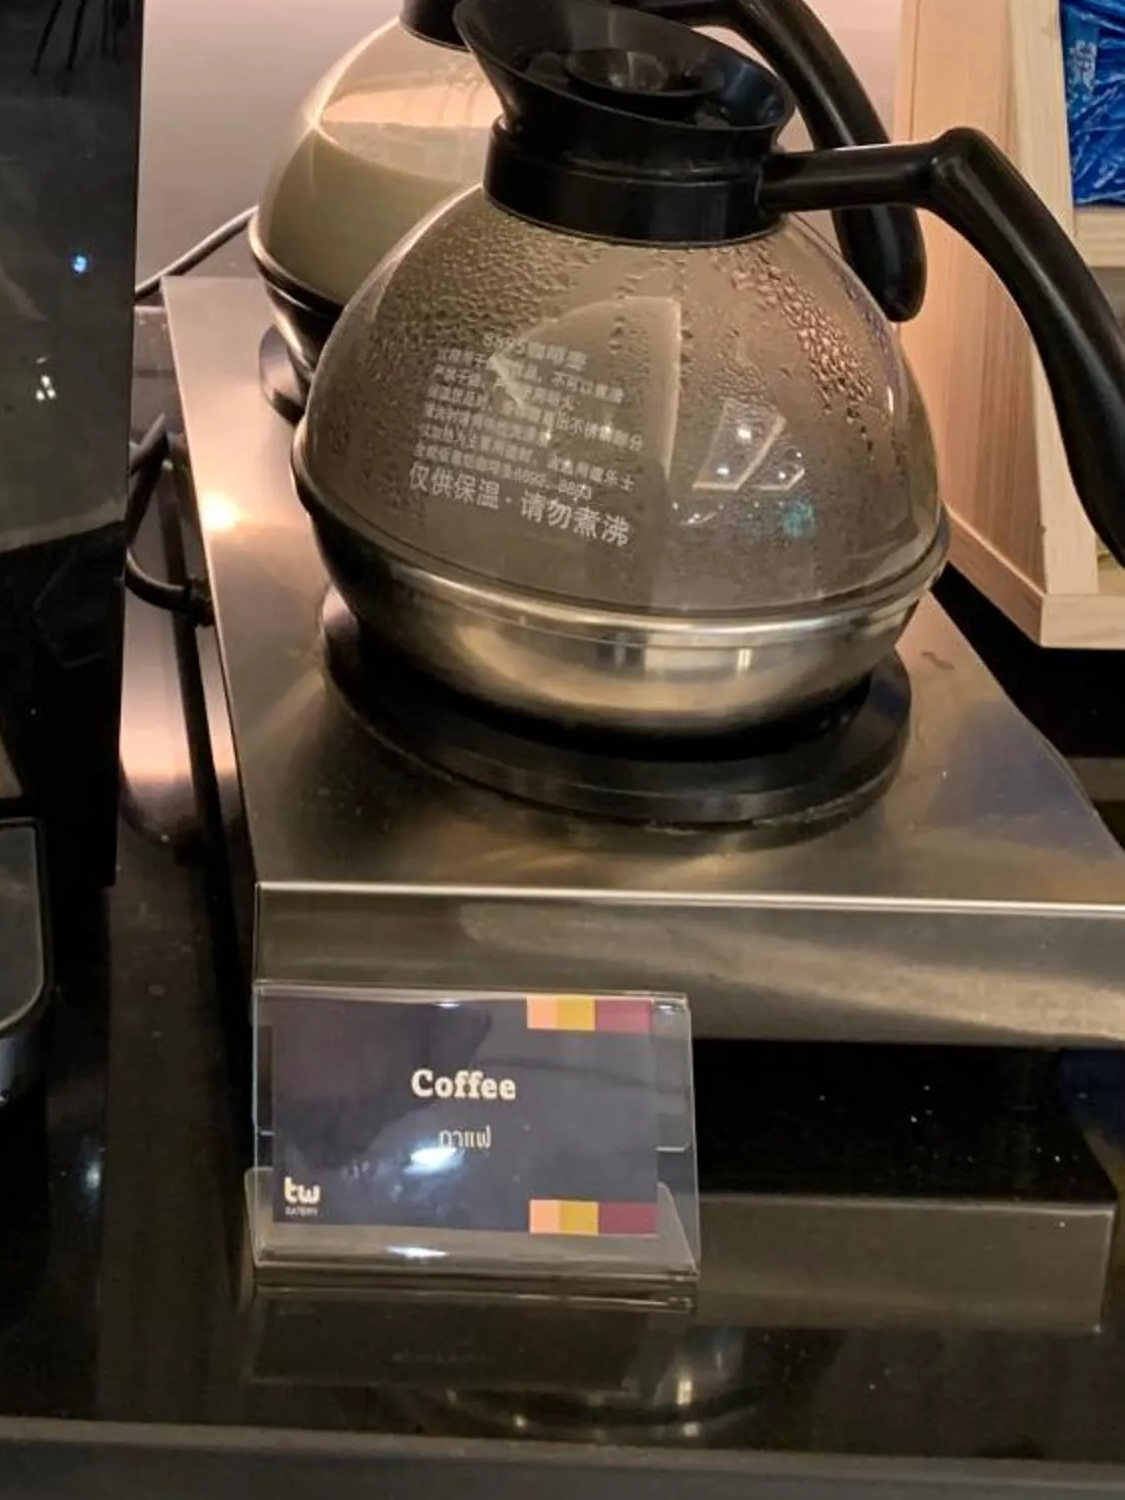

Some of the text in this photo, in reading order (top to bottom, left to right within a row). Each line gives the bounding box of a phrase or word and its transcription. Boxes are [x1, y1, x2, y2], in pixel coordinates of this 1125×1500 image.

[411, 1068, 516, 1100] Coffee
[439, 1125, 492, 1150] กาแฟ
[284, 1176, 321, 1204] tw
